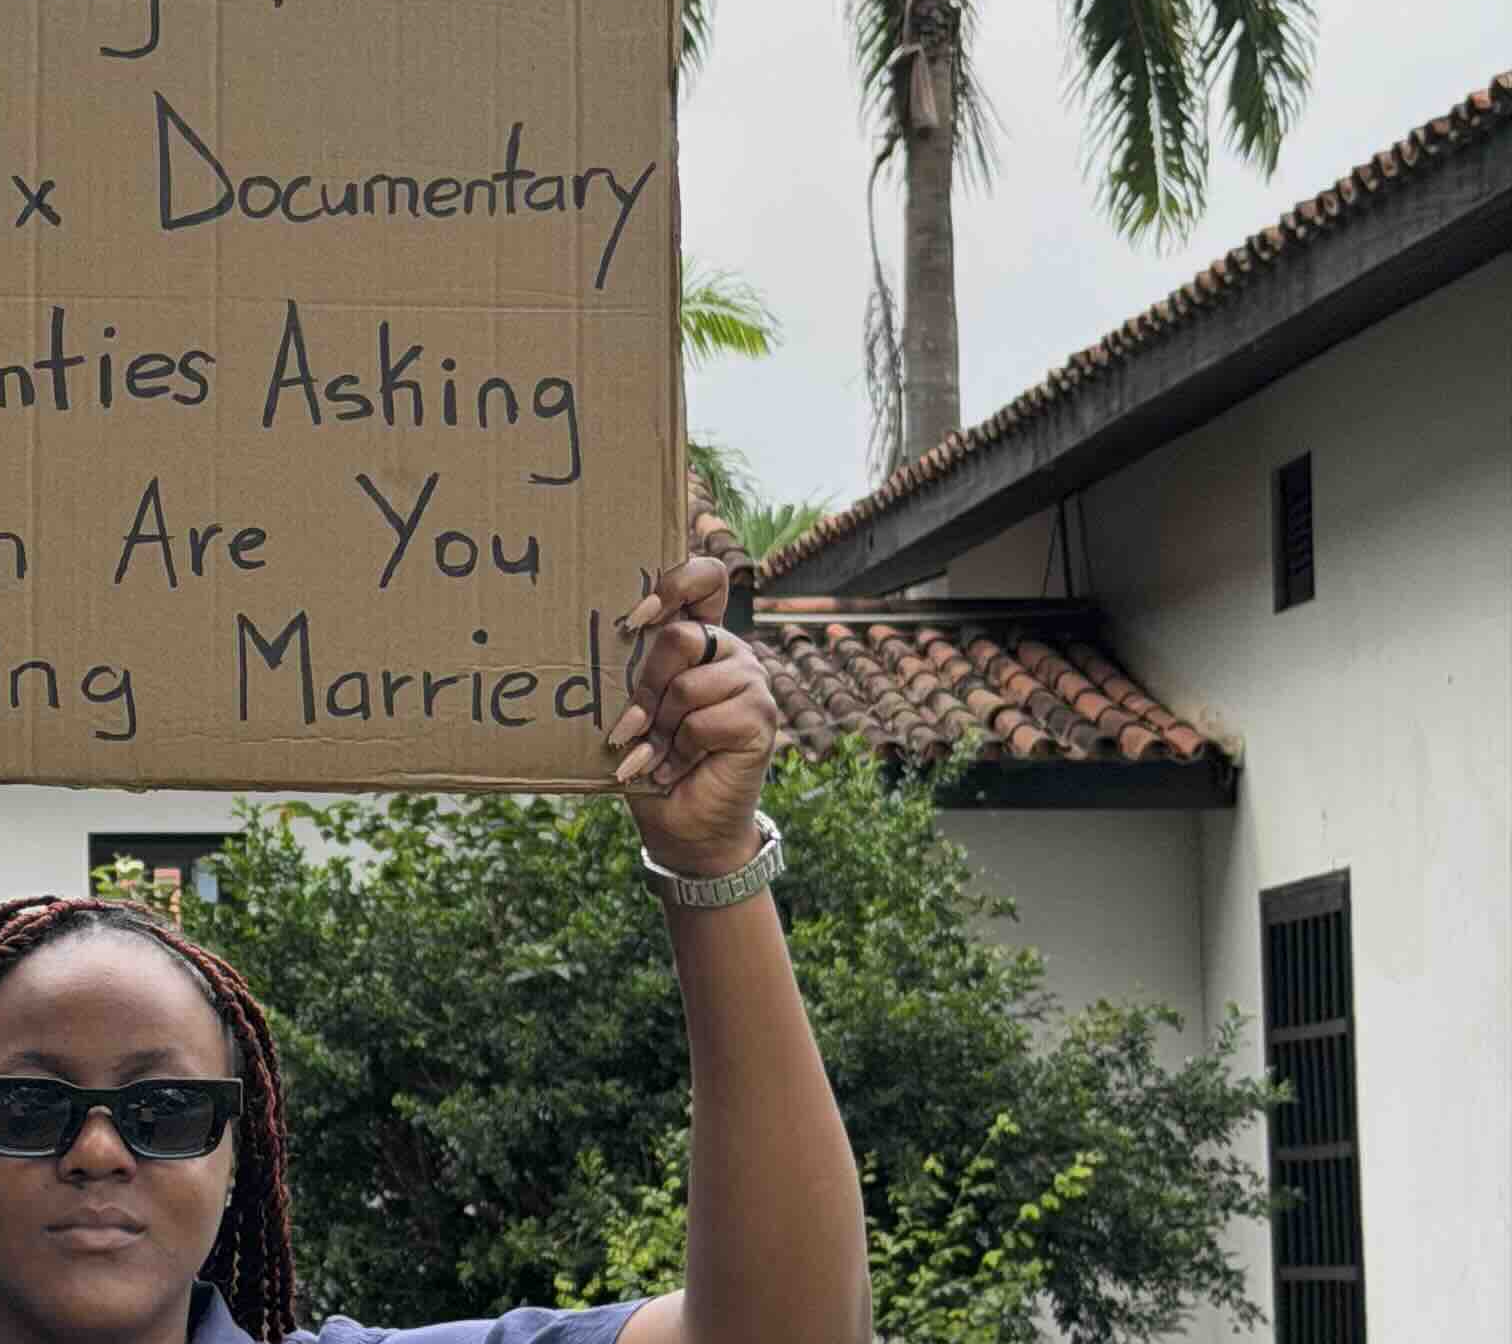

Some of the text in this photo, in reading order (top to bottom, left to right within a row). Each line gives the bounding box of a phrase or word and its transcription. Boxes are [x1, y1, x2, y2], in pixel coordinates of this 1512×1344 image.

[152, 89, 658, 292] Documentary
[261, 297, 584, 488] Asking
[112, 475, 269, 589] Are
[354, 470, 542, 589] You
